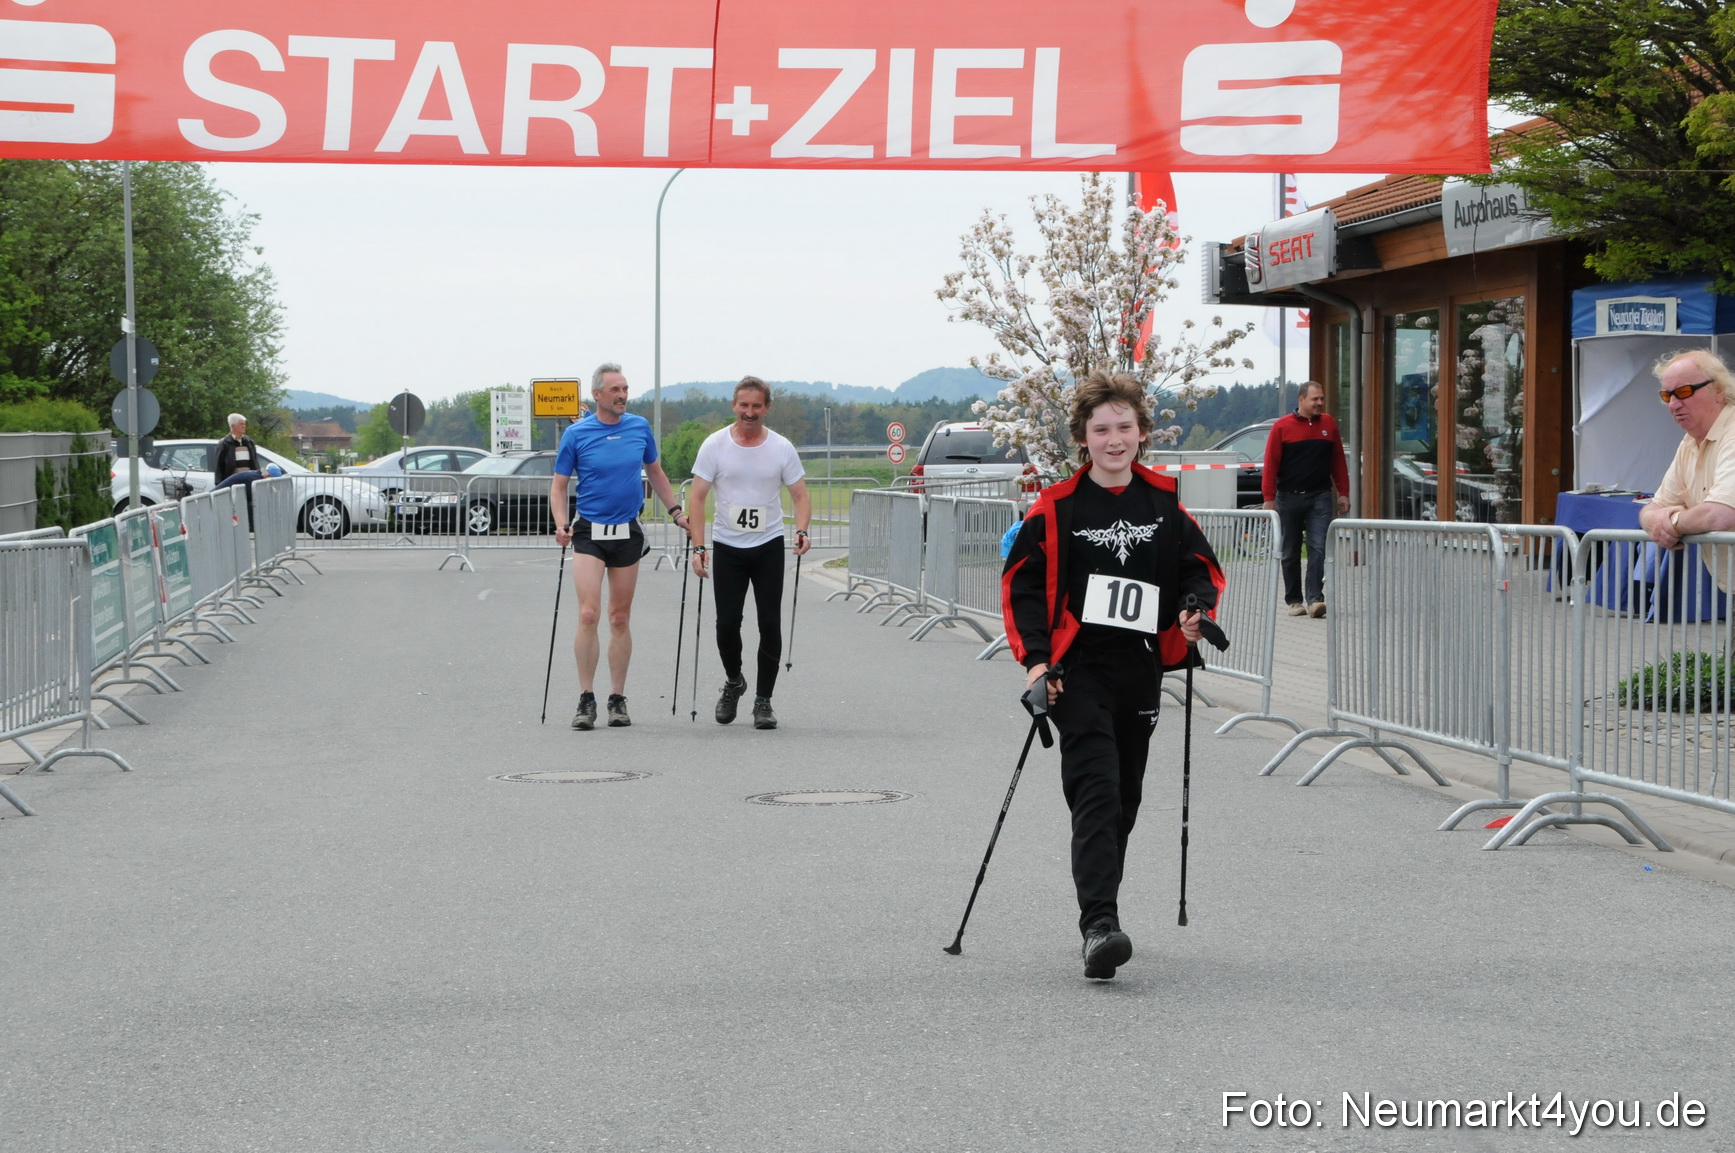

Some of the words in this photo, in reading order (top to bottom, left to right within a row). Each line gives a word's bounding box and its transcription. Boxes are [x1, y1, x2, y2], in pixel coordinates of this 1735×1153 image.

[1453, 192, 1518, 229] Autohaus
[1269, 232, 1315, 267] SEAT
[537, 393, 575, 403] Neumarkt
[891, 428, 901, 437] 60
[736, 508, 759, 529] 45
[1106, 579, 1144, 622] 10
